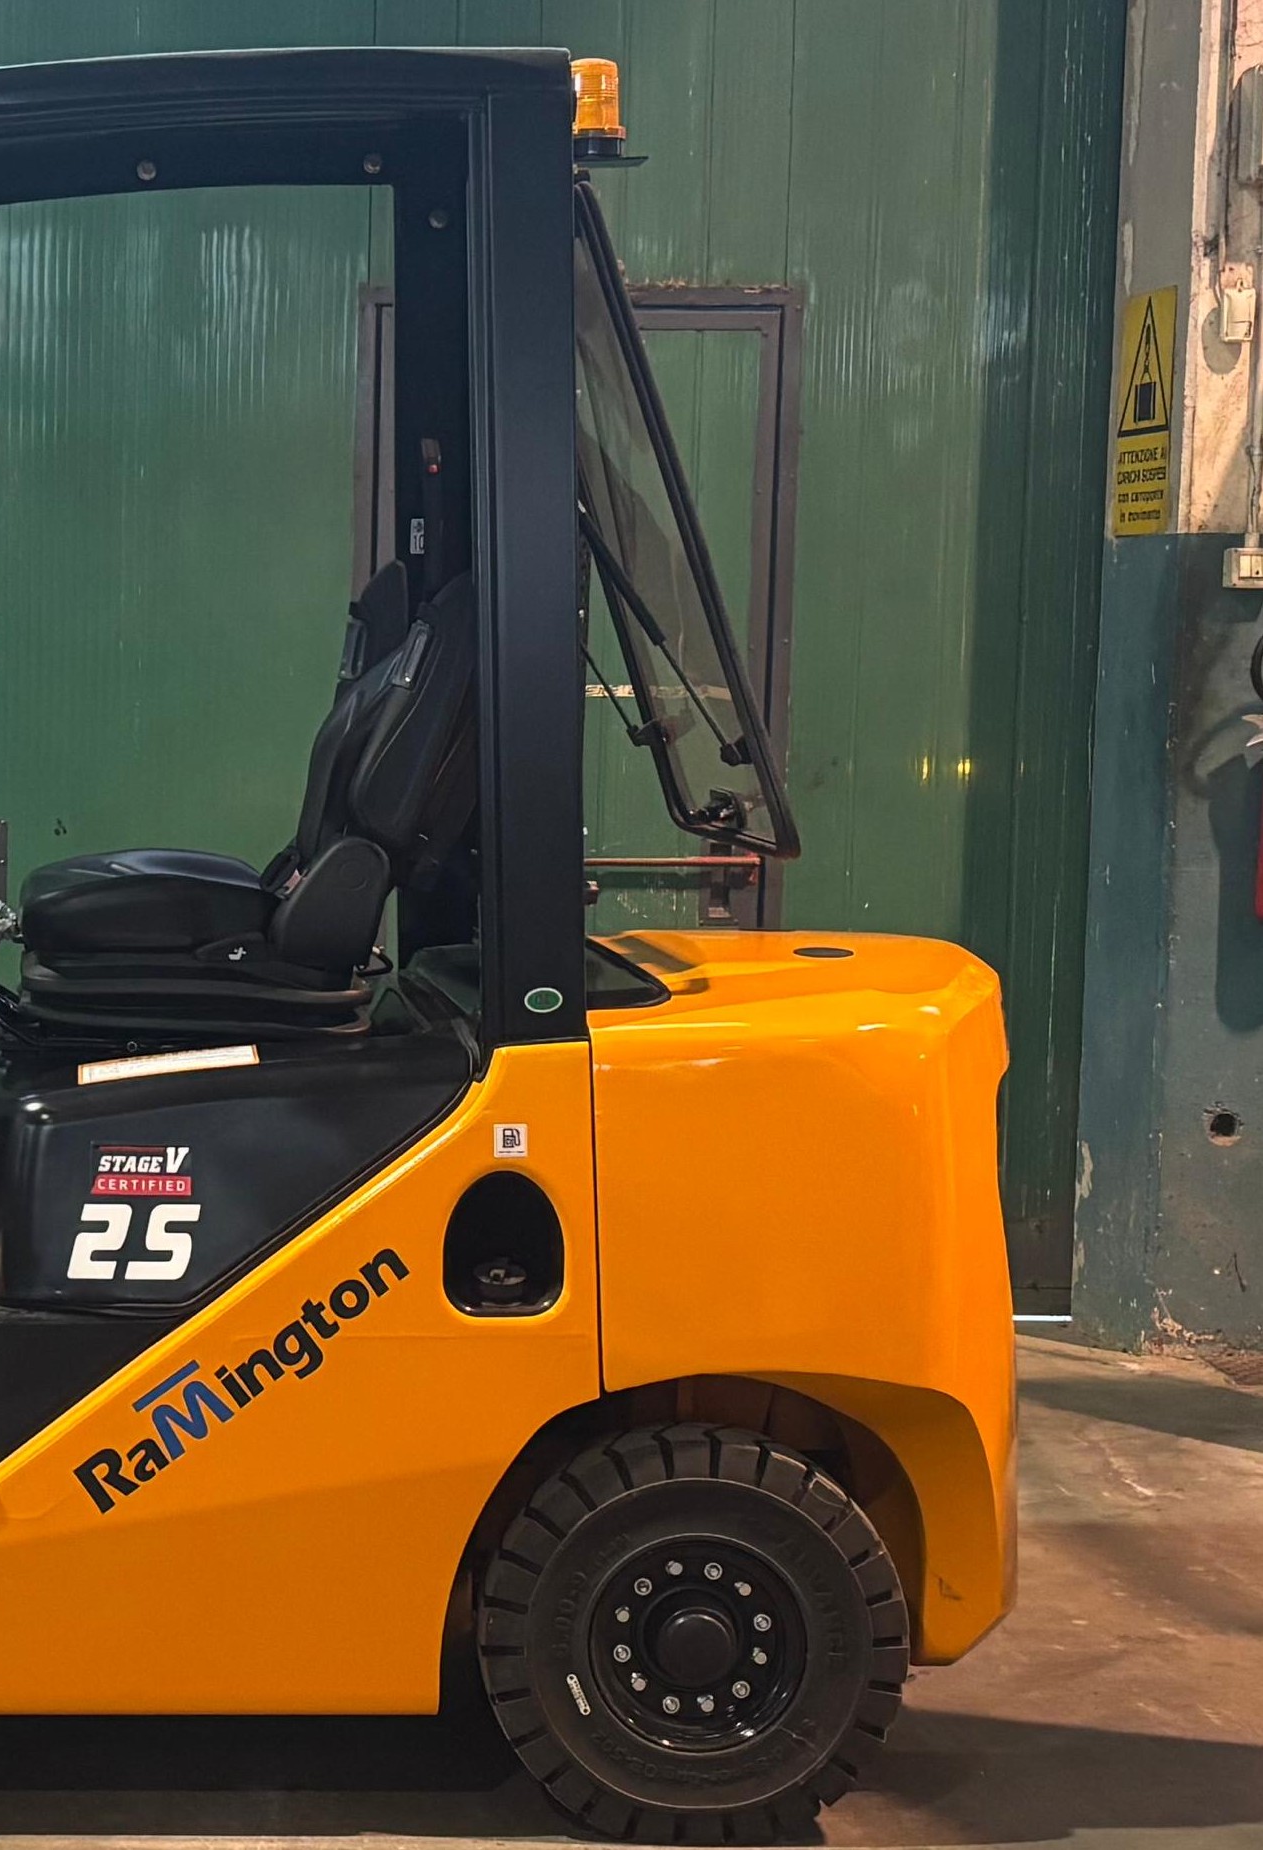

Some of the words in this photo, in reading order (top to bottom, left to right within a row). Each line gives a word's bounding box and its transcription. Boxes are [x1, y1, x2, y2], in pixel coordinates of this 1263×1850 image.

[98, 1155, 164, 1173] STAGE
[166, 1146, 190, 1174] V
[97, 1178, 186, 1192] CERTIFIED
[73, 1248, 410, 1514] RaMington
